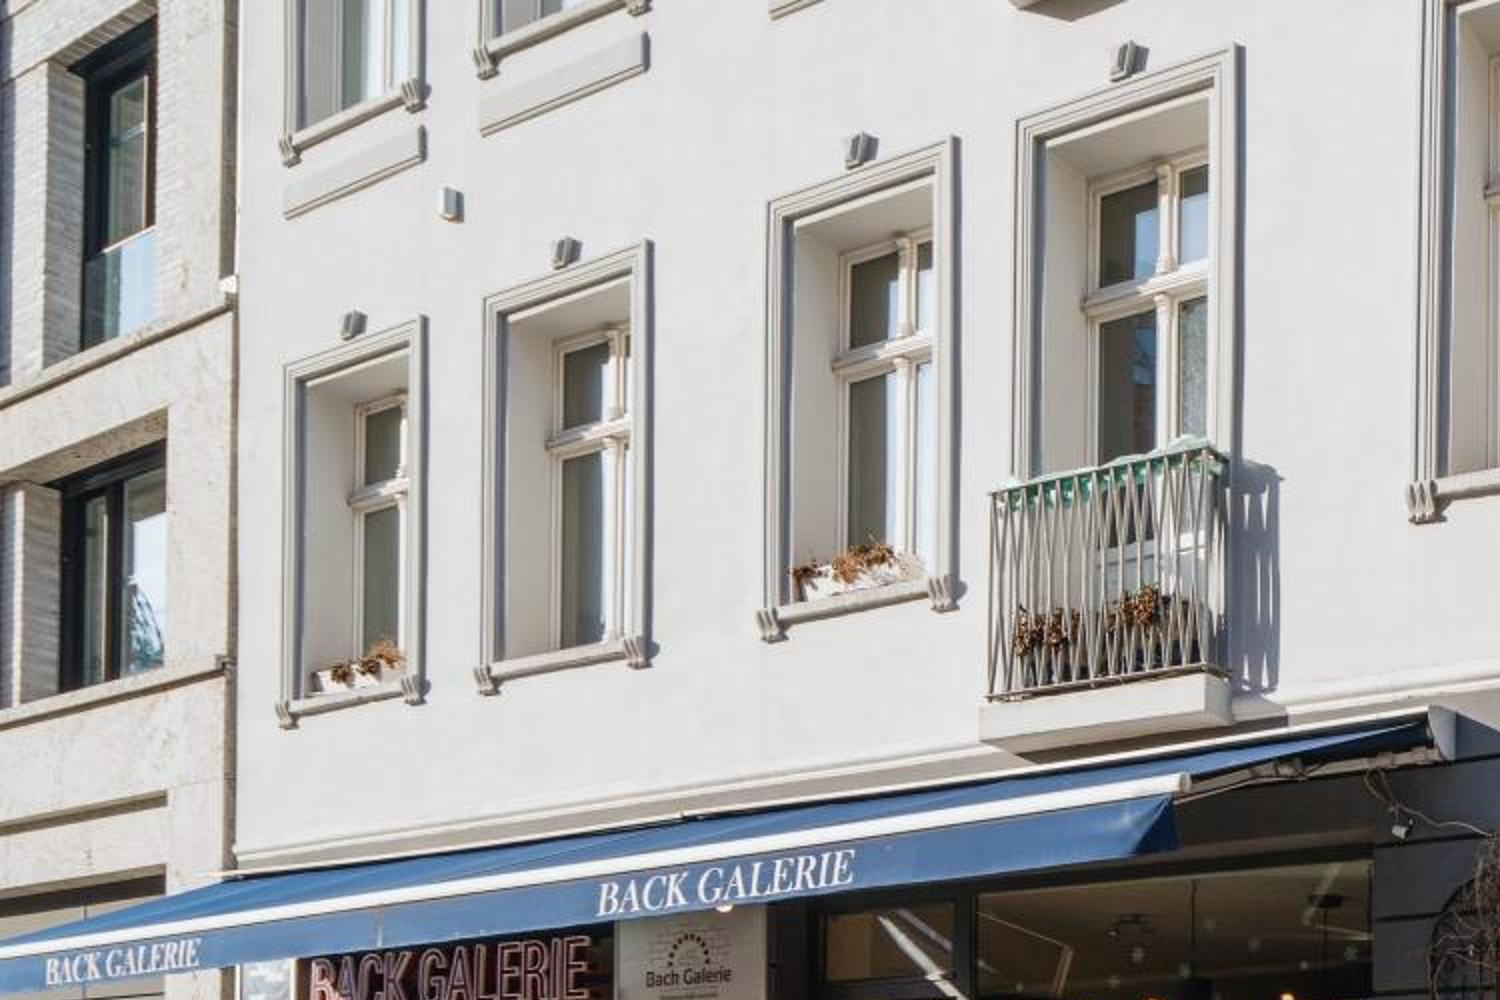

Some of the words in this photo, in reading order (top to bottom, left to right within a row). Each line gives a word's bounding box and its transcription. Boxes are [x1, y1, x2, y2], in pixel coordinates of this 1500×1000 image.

[594, 871, 689, 918] BACK
[697, 848, 857, 905] GALERIE
[45, 951, 102, 986] BACK
[105, 938, 202, 978] GALERIE
[683, 966, 733, 985] Galerie
